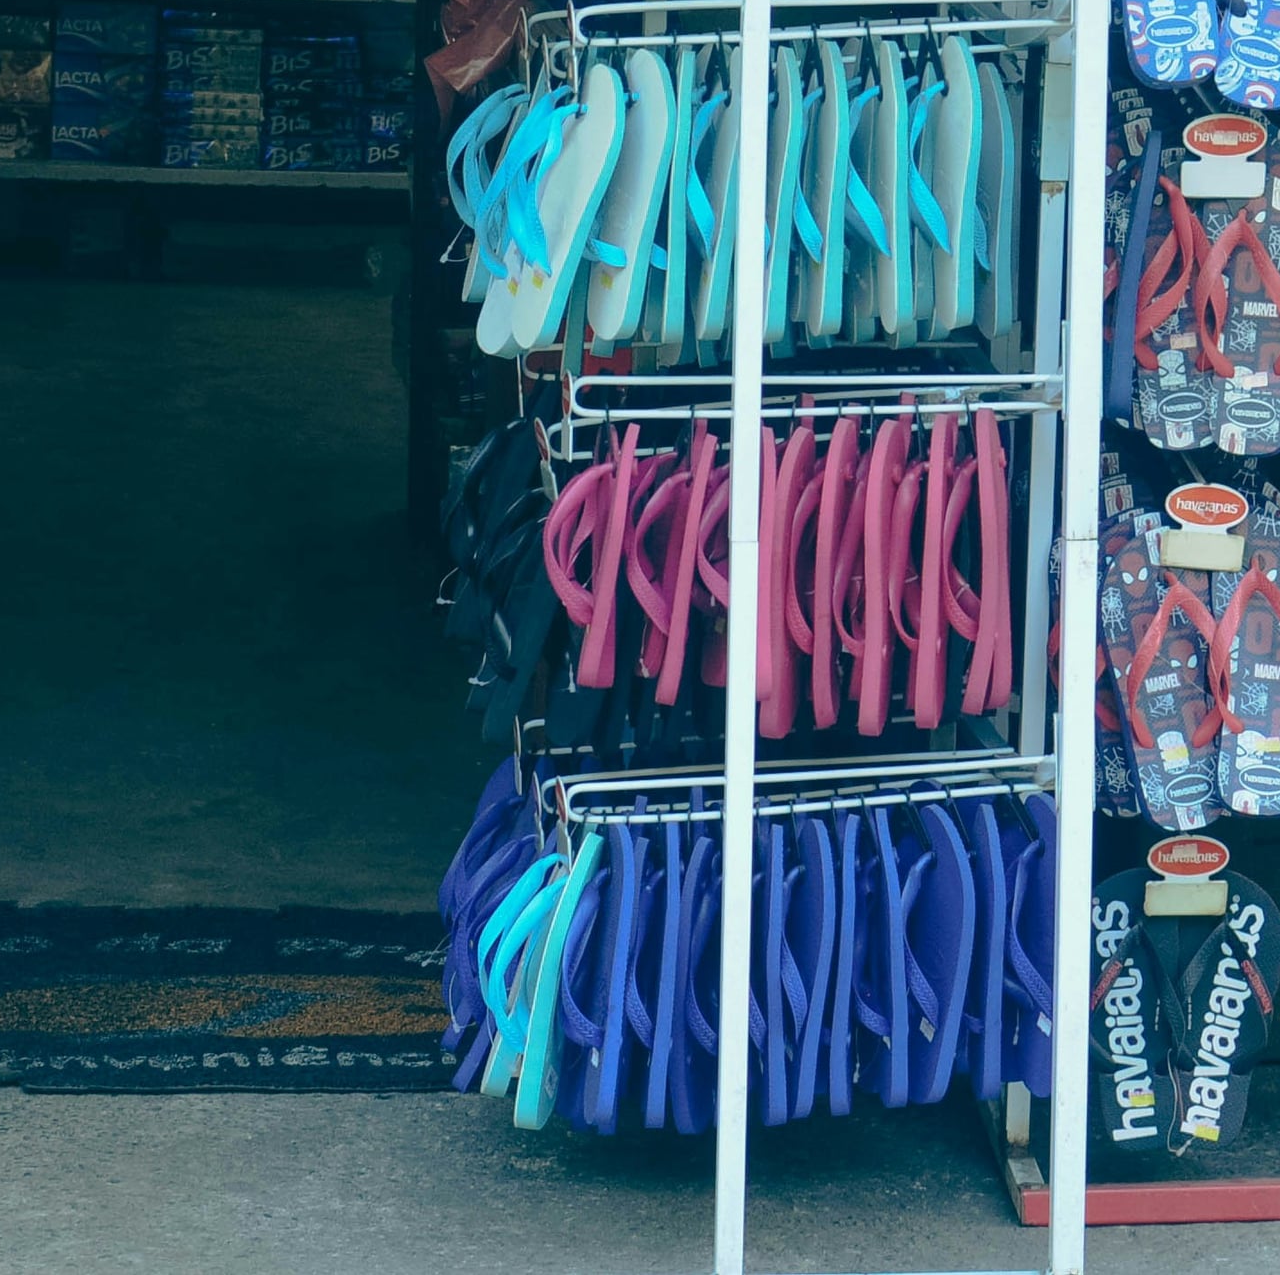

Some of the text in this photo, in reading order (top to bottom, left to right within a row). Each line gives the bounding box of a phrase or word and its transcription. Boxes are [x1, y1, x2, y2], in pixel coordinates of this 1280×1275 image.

[54, 70, 103, 86] LACTA
[52, 125, 100, 141] LACTA
[1144, 672, 1182, 694] MARVEL
